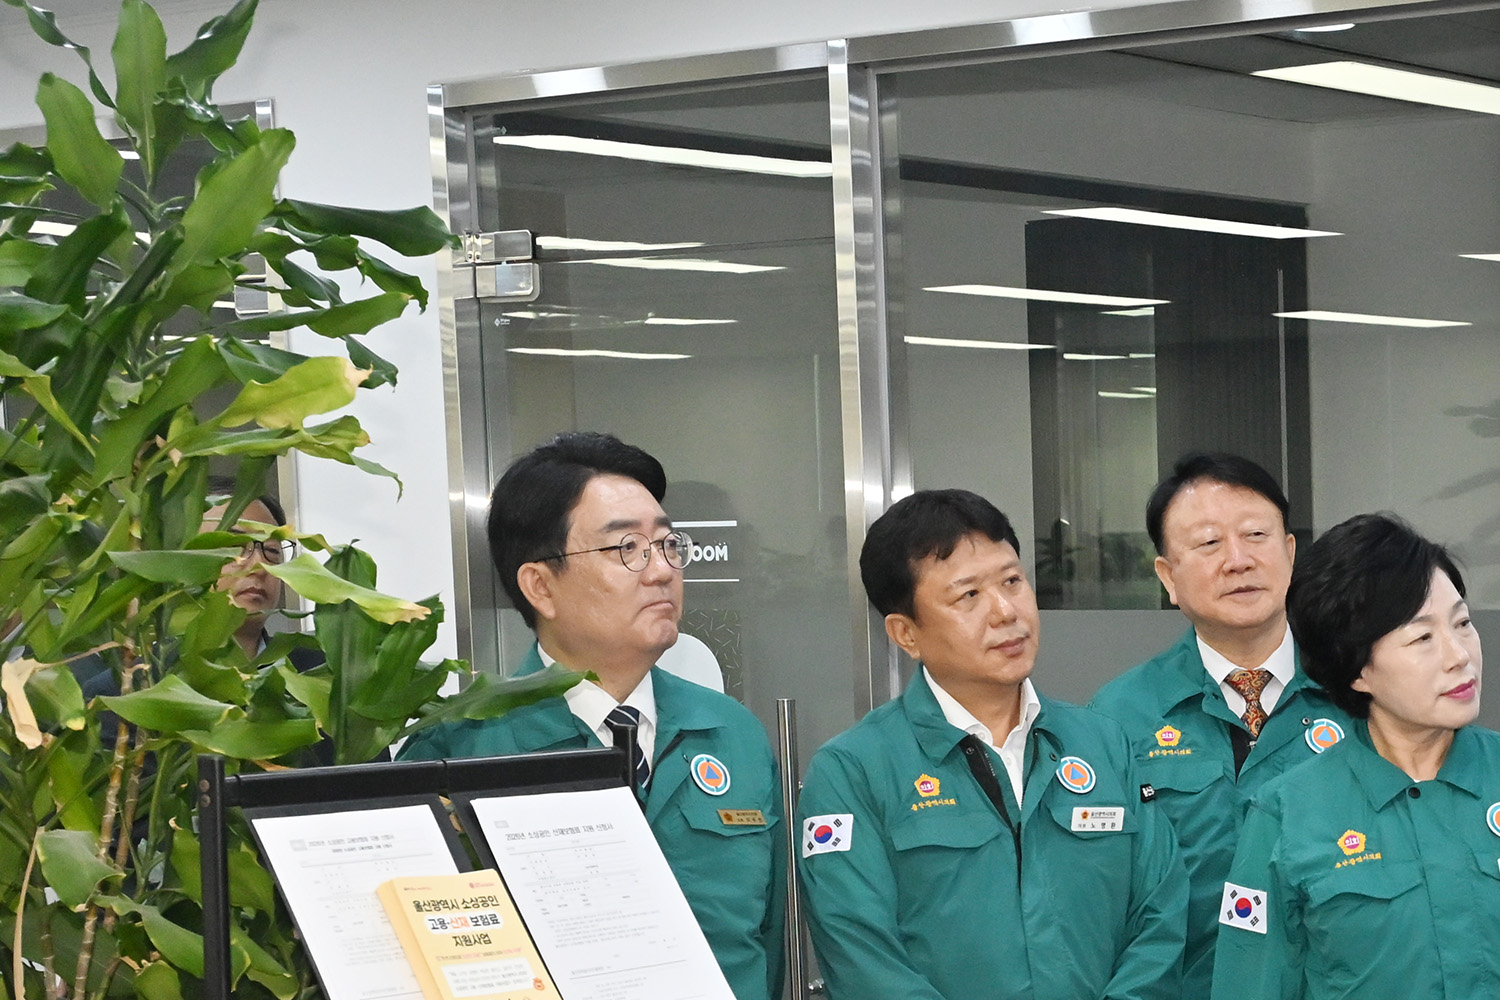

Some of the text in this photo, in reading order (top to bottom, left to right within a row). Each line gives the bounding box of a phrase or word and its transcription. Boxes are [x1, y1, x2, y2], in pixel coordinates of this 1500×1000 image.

[691, 545, 728, 561] OOM
[412, 895, 500, 913] 울산광역시 소상공인
[471, 913, 500, 927] 보험료
[452, 933, 492, 947] 지원사업
